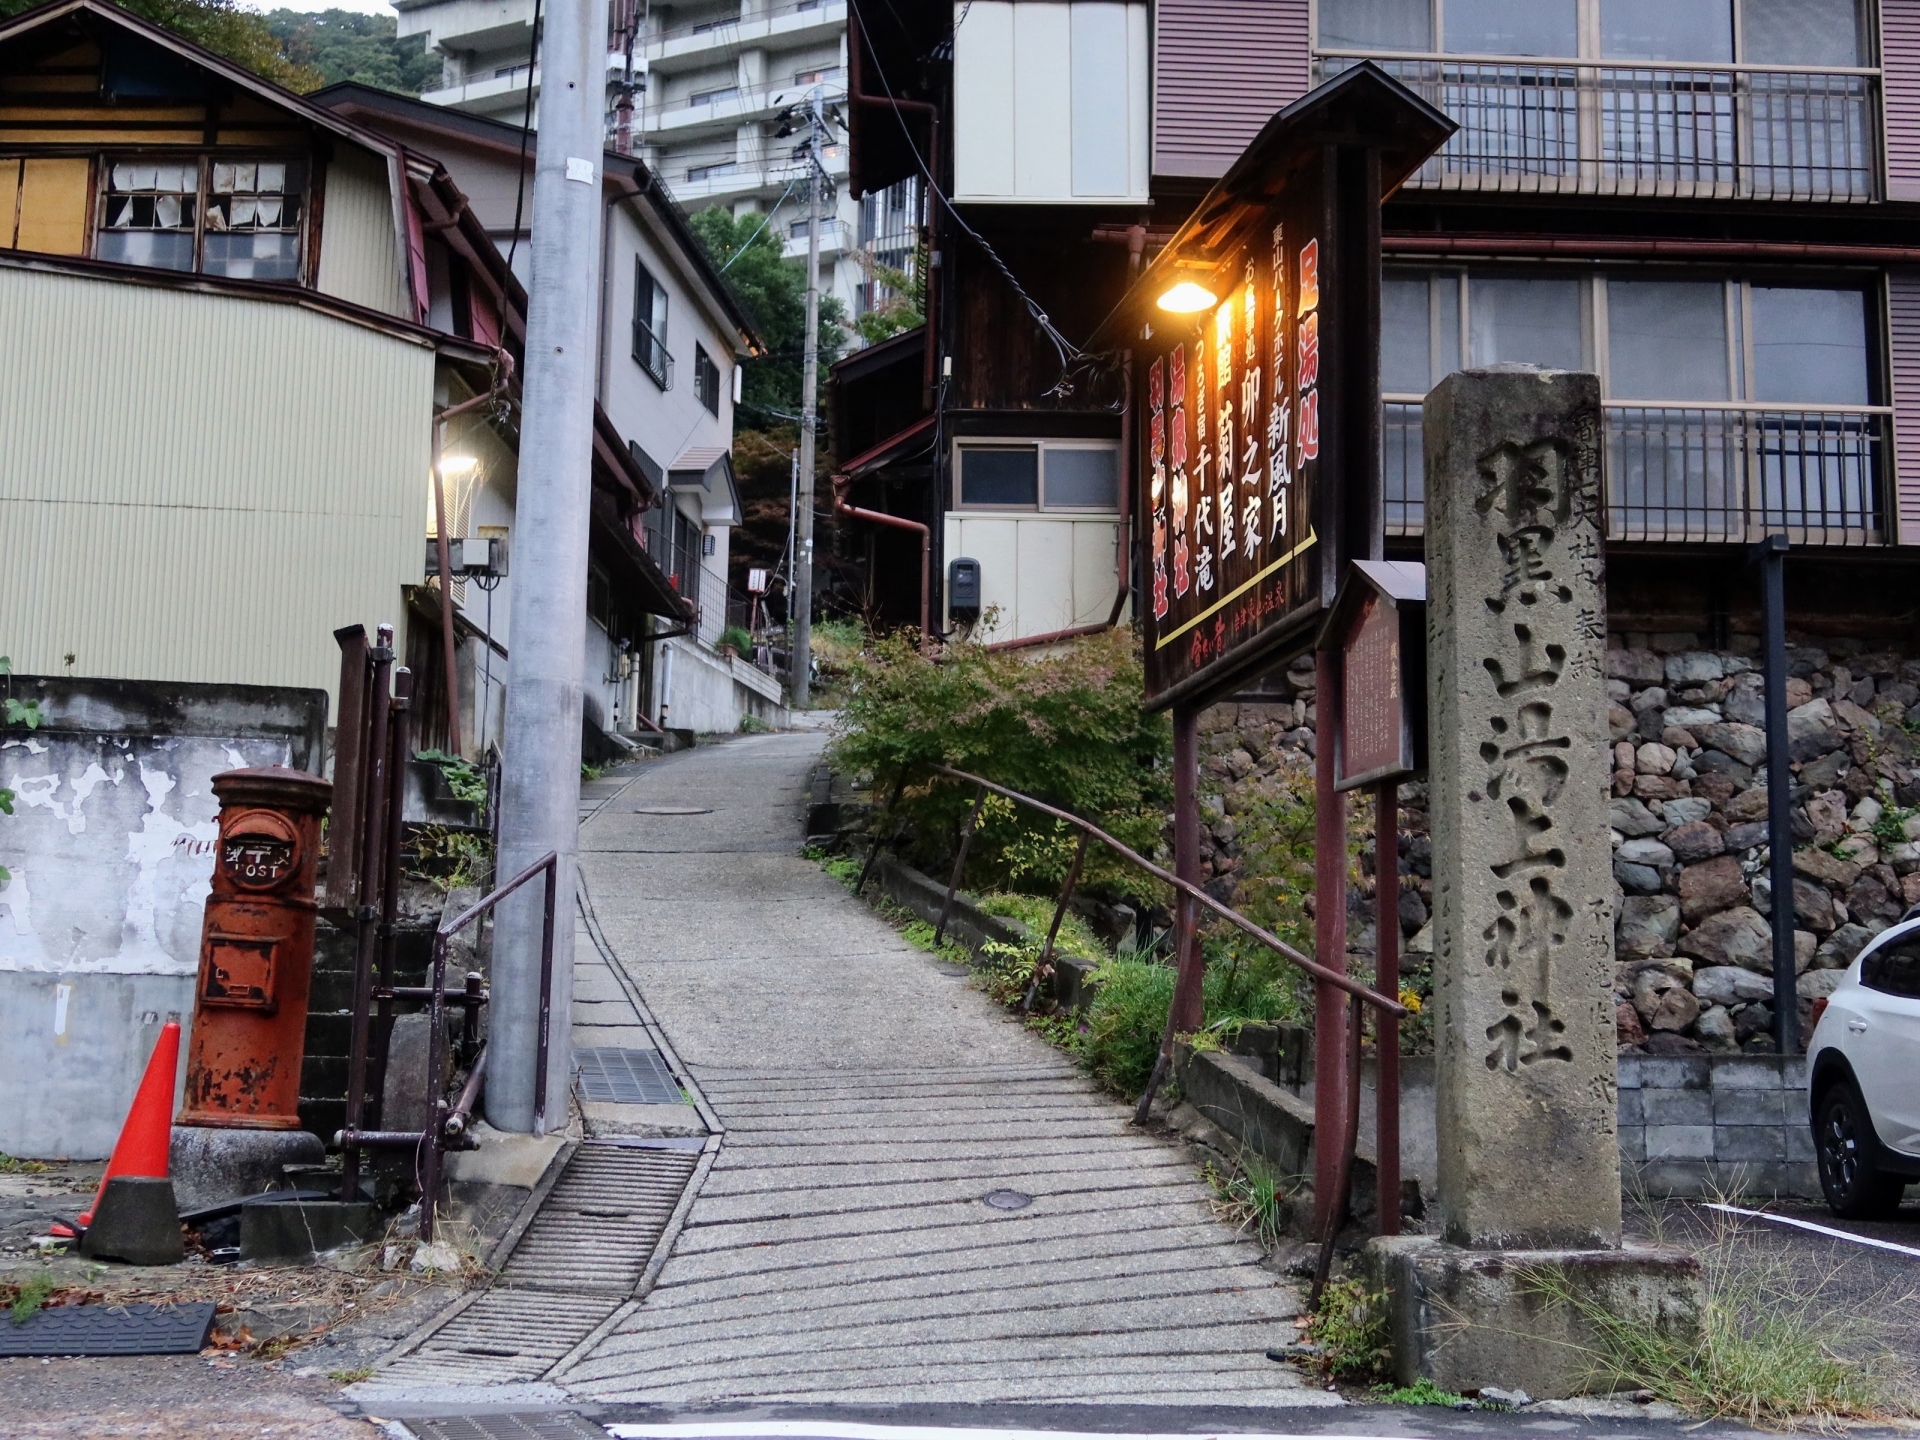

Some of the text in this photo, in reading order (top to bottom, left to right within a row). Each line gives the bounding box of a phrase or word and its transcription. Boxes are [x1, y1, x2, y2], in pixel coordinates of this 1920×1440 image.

[1242, 257, 1262, 560] お食事処 卯之家
[1267, 222, 1291, 544] 東山パークホテル 新風月
[1297, 237, 1319, 469] 足湯処
[1193, 444, 1213, 597] 千代滝
